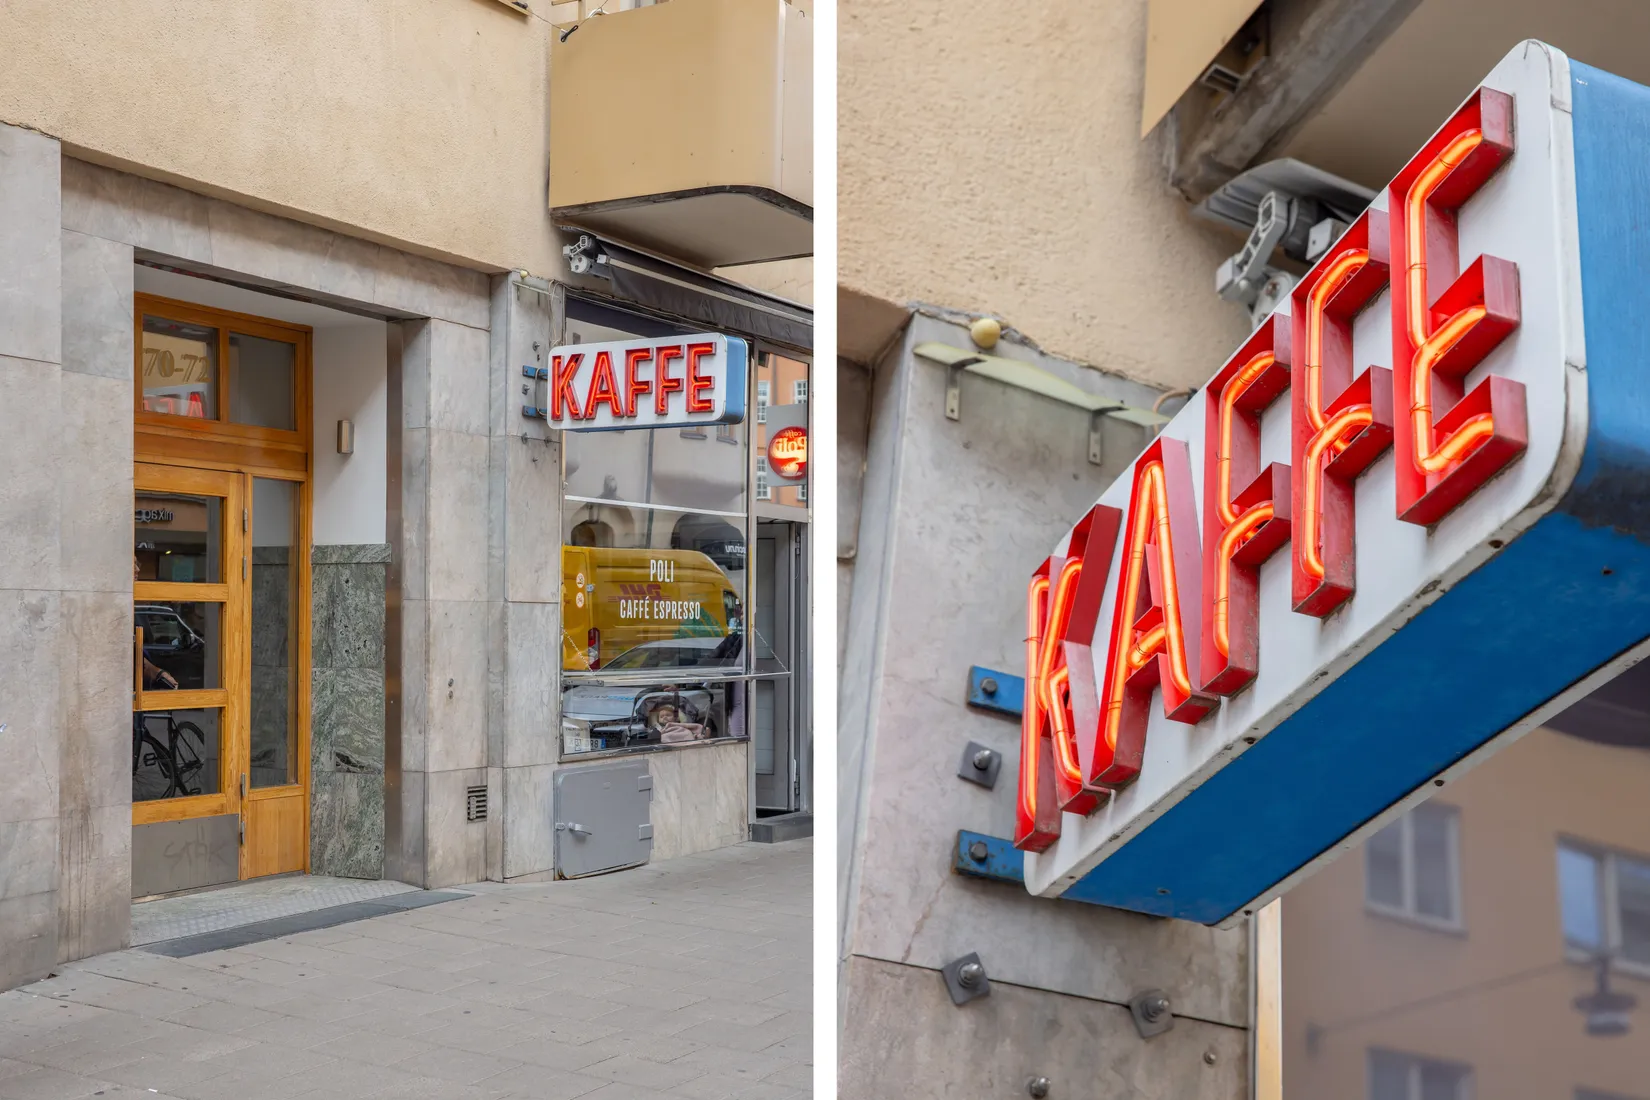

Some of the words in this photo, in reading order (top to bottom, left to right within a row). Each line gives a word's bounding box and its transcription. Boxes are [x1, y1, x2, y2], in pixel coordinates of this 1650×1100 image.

[143, 347, 212, 383] 70-72
[551, 342, 716, 420] KAFFE
[1014, 86, 1527, 853] KAFFE
[650, 559, 674, 583] POLI
[620, 596, 650, 619] CAFFÉ
[653, 601, 701, 620] ESPRESSO
